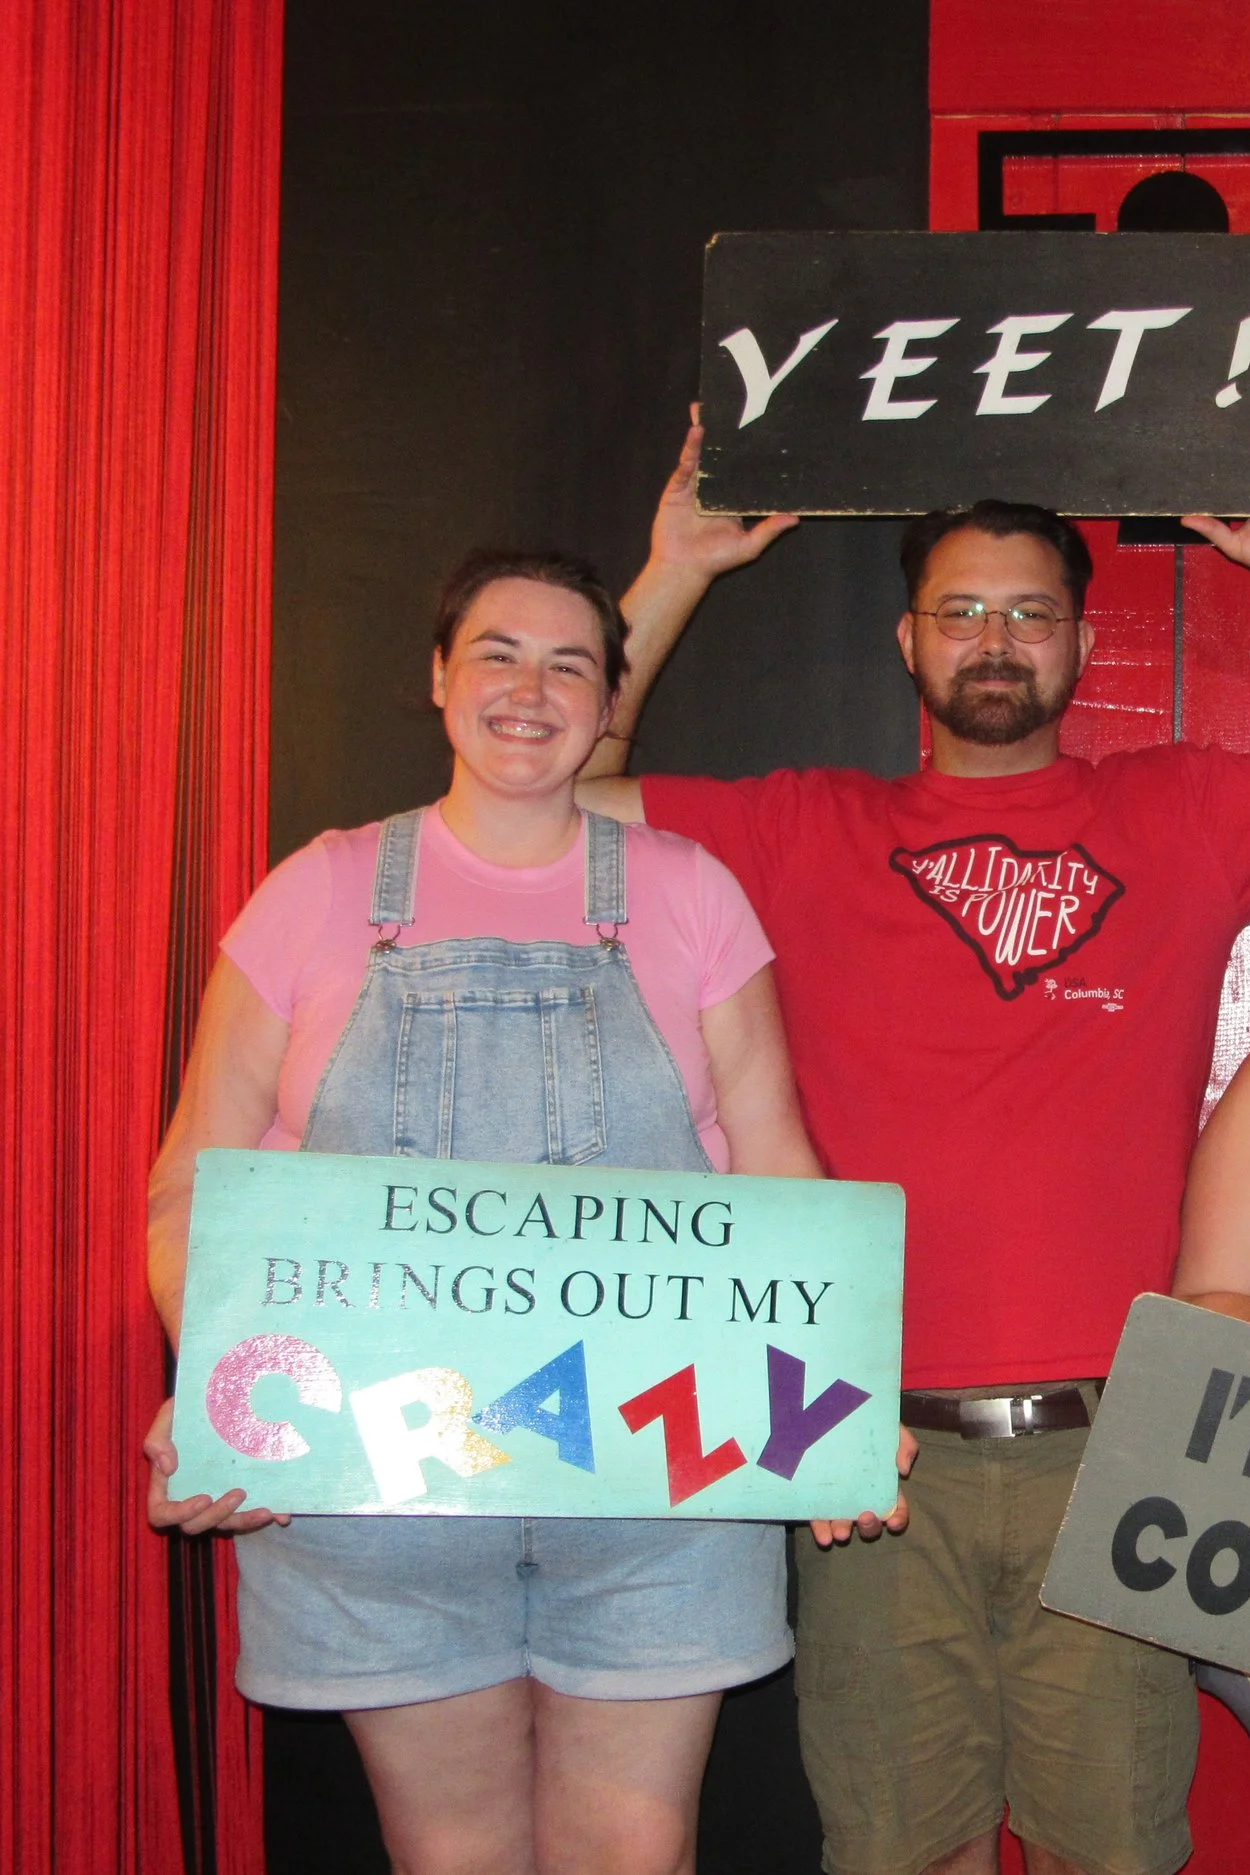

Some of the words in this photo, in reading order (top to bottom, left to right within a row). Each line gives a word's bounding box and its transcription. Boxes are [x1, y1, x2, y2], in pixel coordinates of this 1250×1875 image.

[929, 885, 961, 903] IS
[961, 887, 1080, 966] POWER
[1112, 988, 1125, 999] SC
[378, 1184, 736, 1248] ESCAPING
[261, 1257, 538, 1316] BRINGS
[559, 1270, 705, 1322] OUT
[726, 1277, 836, 1326] MY
[205, 1332, 874, 1511] CRAZY
